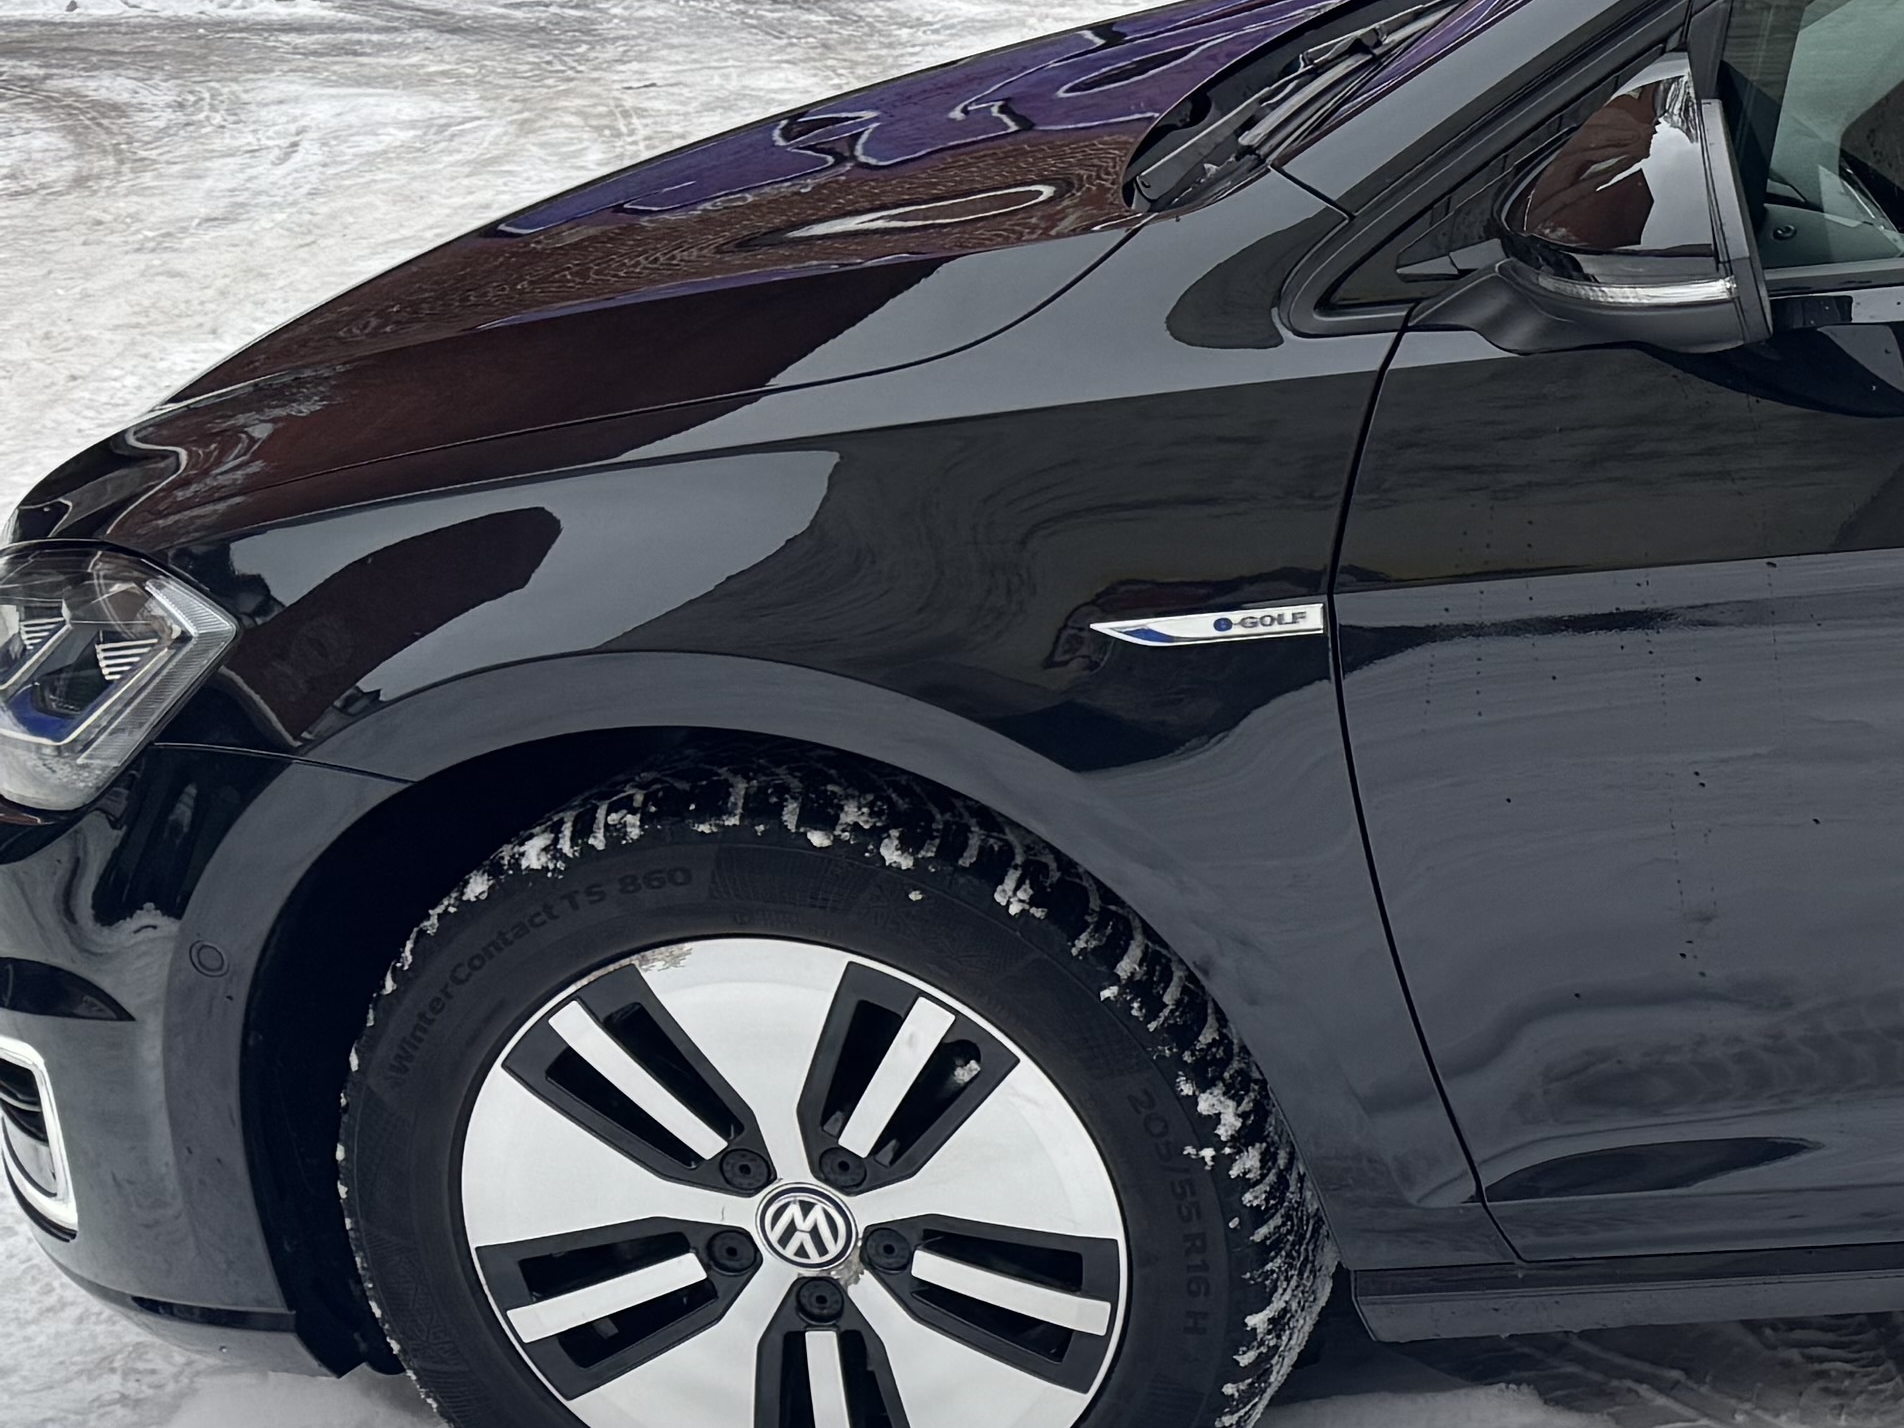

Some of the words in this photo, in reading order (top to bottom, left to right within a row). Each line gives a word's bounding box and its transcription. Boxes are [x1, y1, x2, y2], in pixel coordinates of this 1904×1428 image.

[560, 881, 607, 913] TS
[616, 866, 693, 895] 860
[1181, 1230, 1211, 1298] R16
[1182, 1310, 1210, 1336] H
